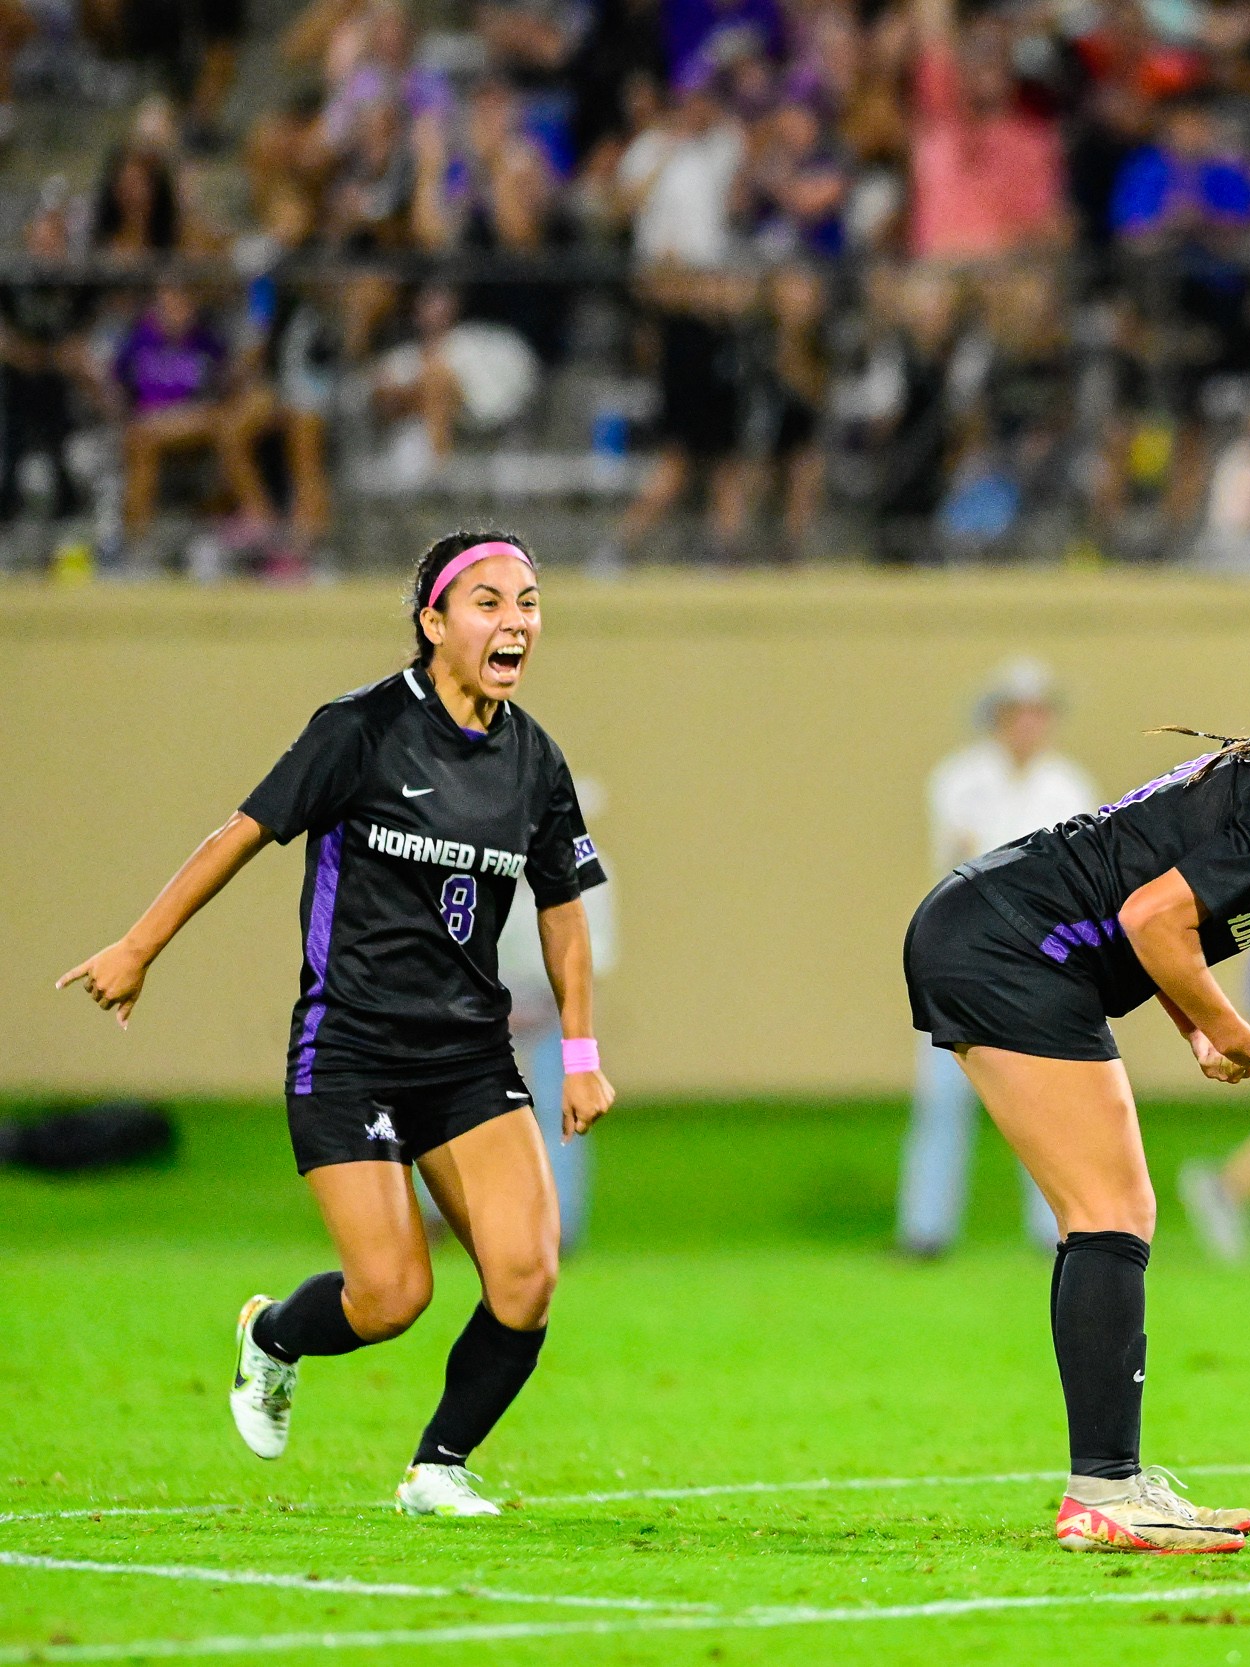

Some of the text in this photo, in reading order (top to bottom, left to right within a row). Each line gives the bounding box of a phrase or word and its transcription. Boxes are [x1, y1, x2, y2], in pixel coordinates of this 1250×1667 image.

[368, 823, 528, 879] HORNED FRO
[440, 873, 477, 945] 8
